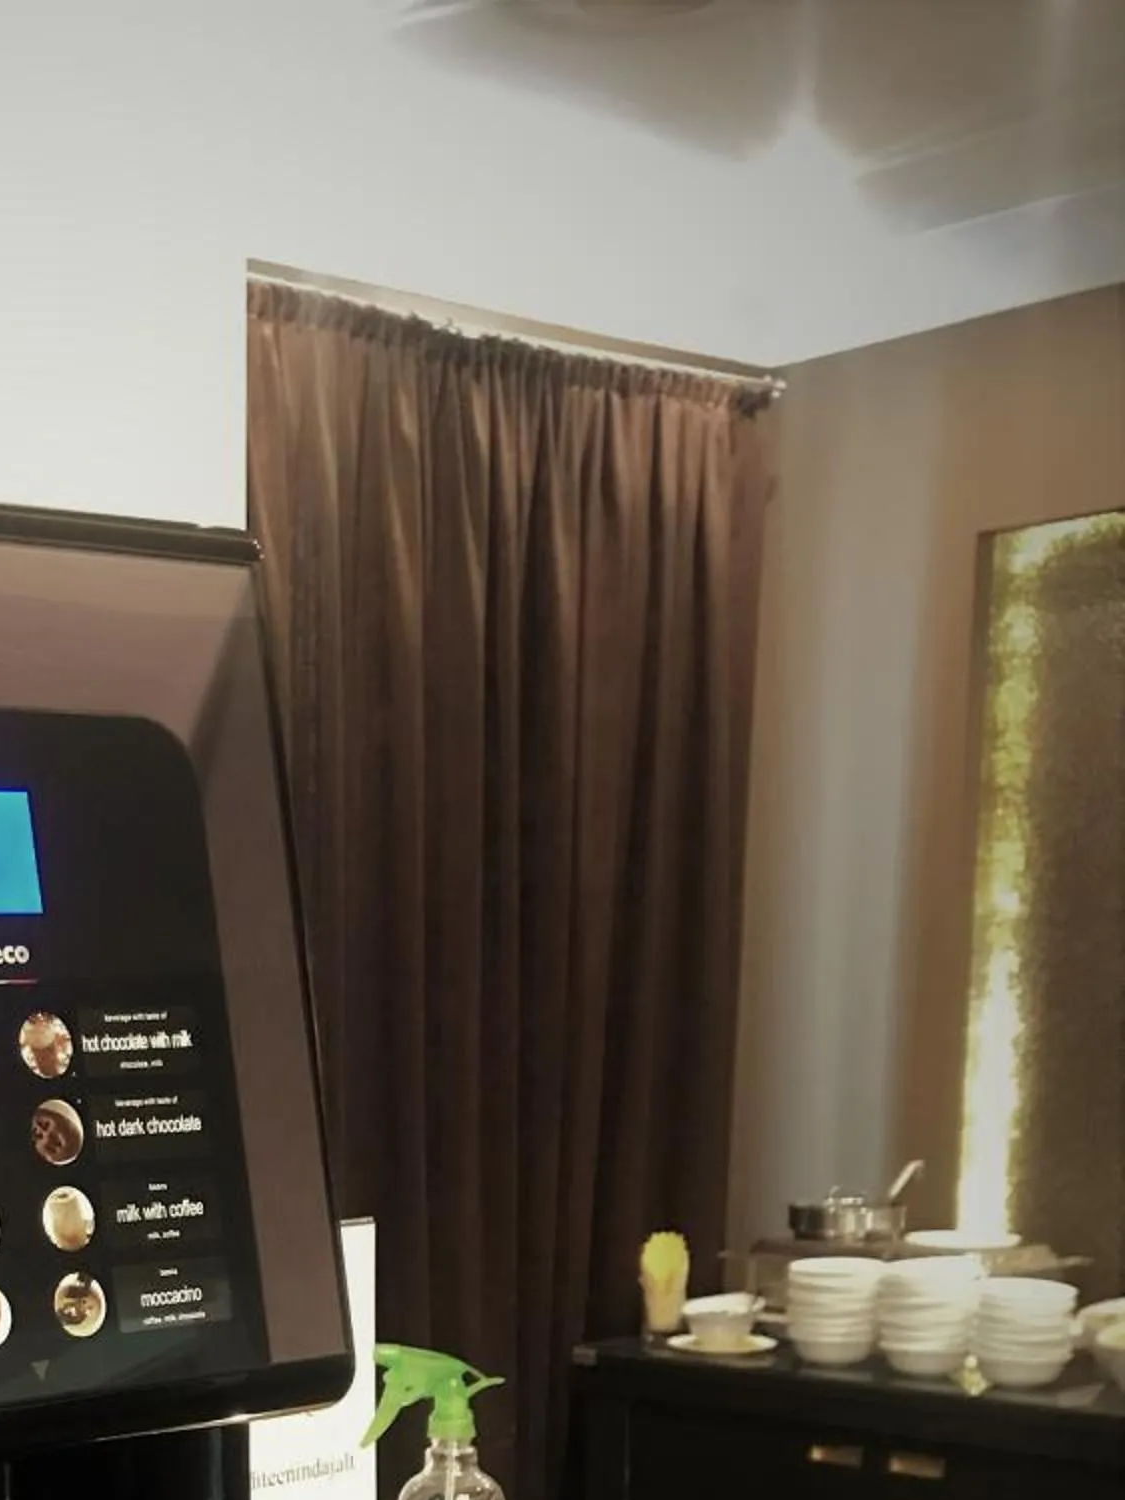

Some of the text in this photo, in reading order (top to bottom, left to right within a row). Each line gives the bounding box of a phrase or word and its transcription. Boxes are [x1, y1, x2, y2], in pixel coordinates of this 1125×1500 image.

[81, 1028, 193, 1052] hot chocolate with milk
[96, 1113, 202, 1137] hot dark chocolate
[116, 1198, 204, 1223] milk with coffee
[140, 1285, 203, 1307] moccacino
